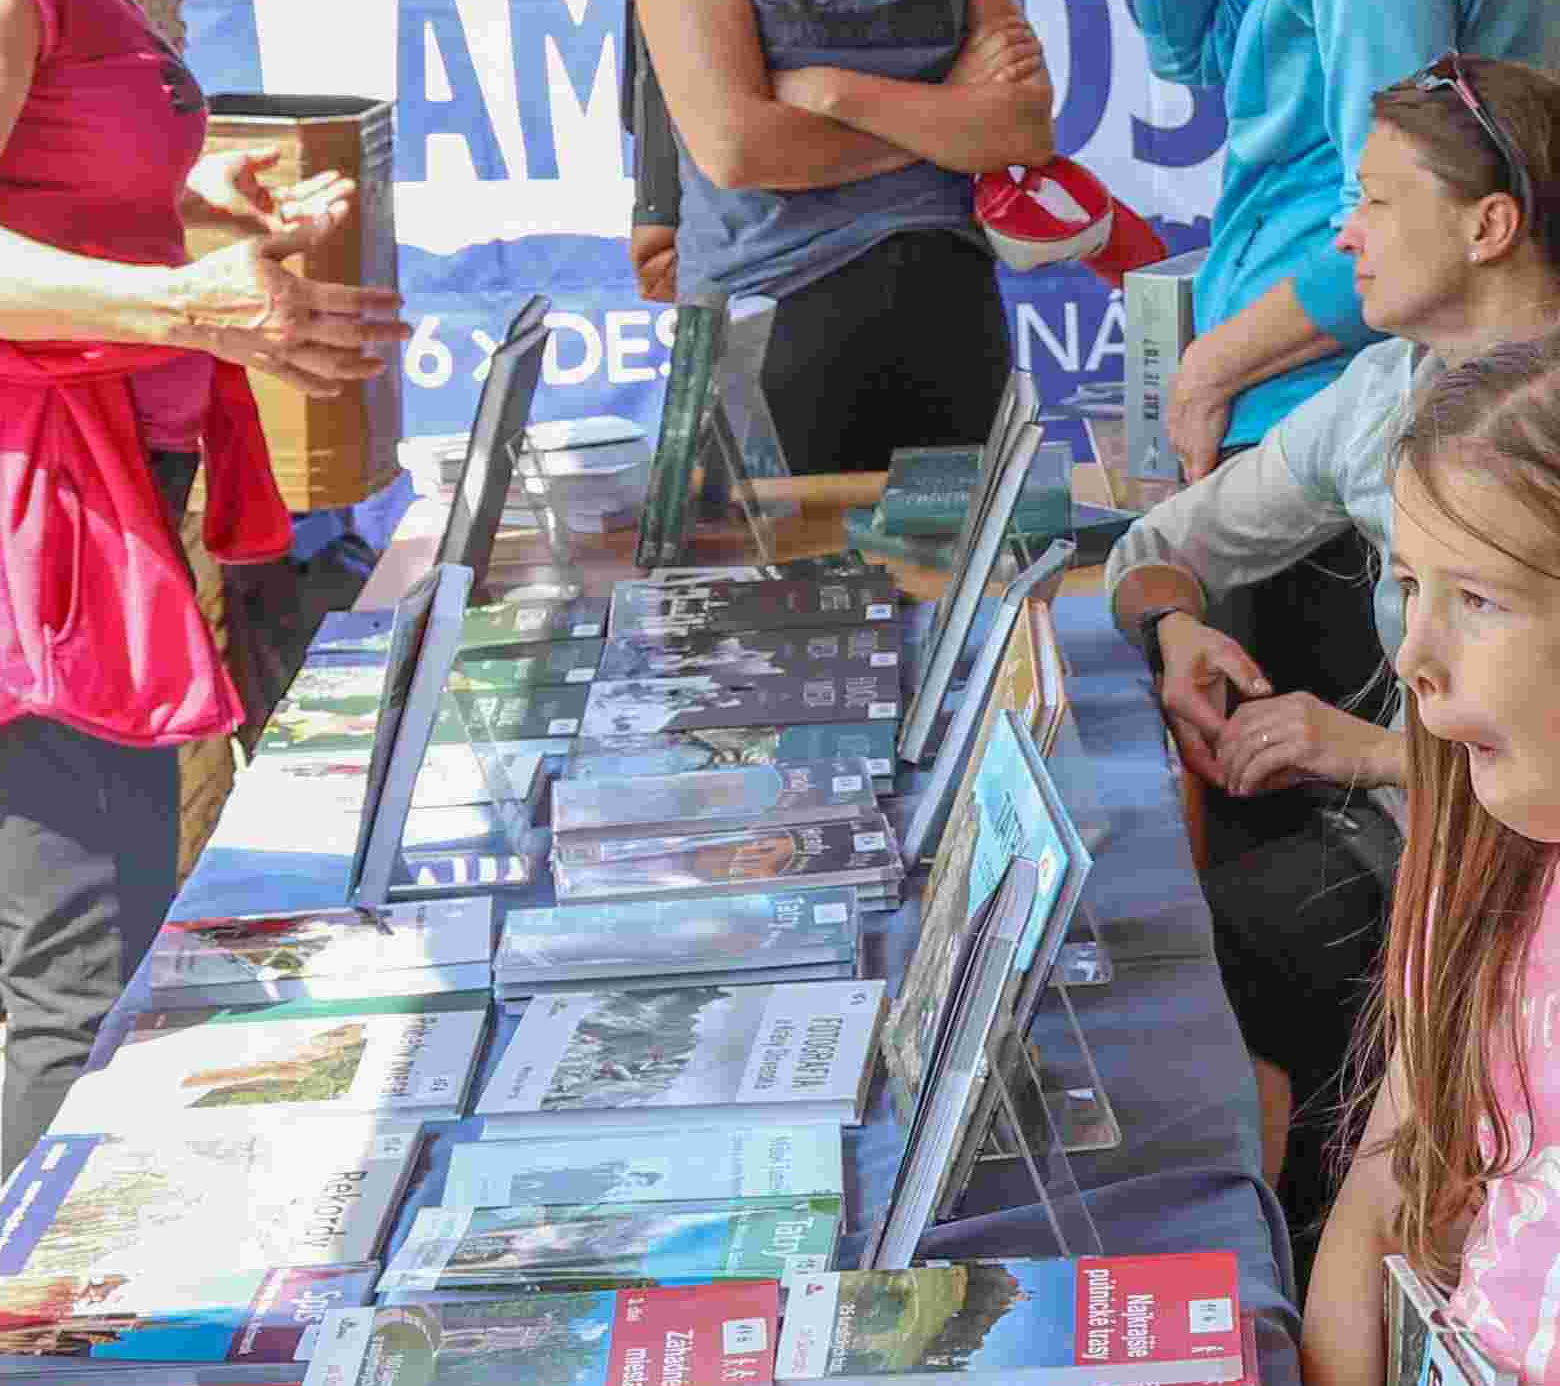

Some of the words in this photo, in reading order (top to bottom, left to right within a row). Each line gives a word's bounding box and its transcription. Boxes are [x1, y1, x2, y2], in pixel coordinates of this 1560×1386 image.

[791, 1016, 844, 1091] FOTOGRAFIA
[303, 1169, 368, 1250] Rekordy
[775, 1217, 816, 1259] Tatry
[1082, 1328, 1113, 1360] trasy
[1122, 1293, 1157, 1358] Najkrajšie
